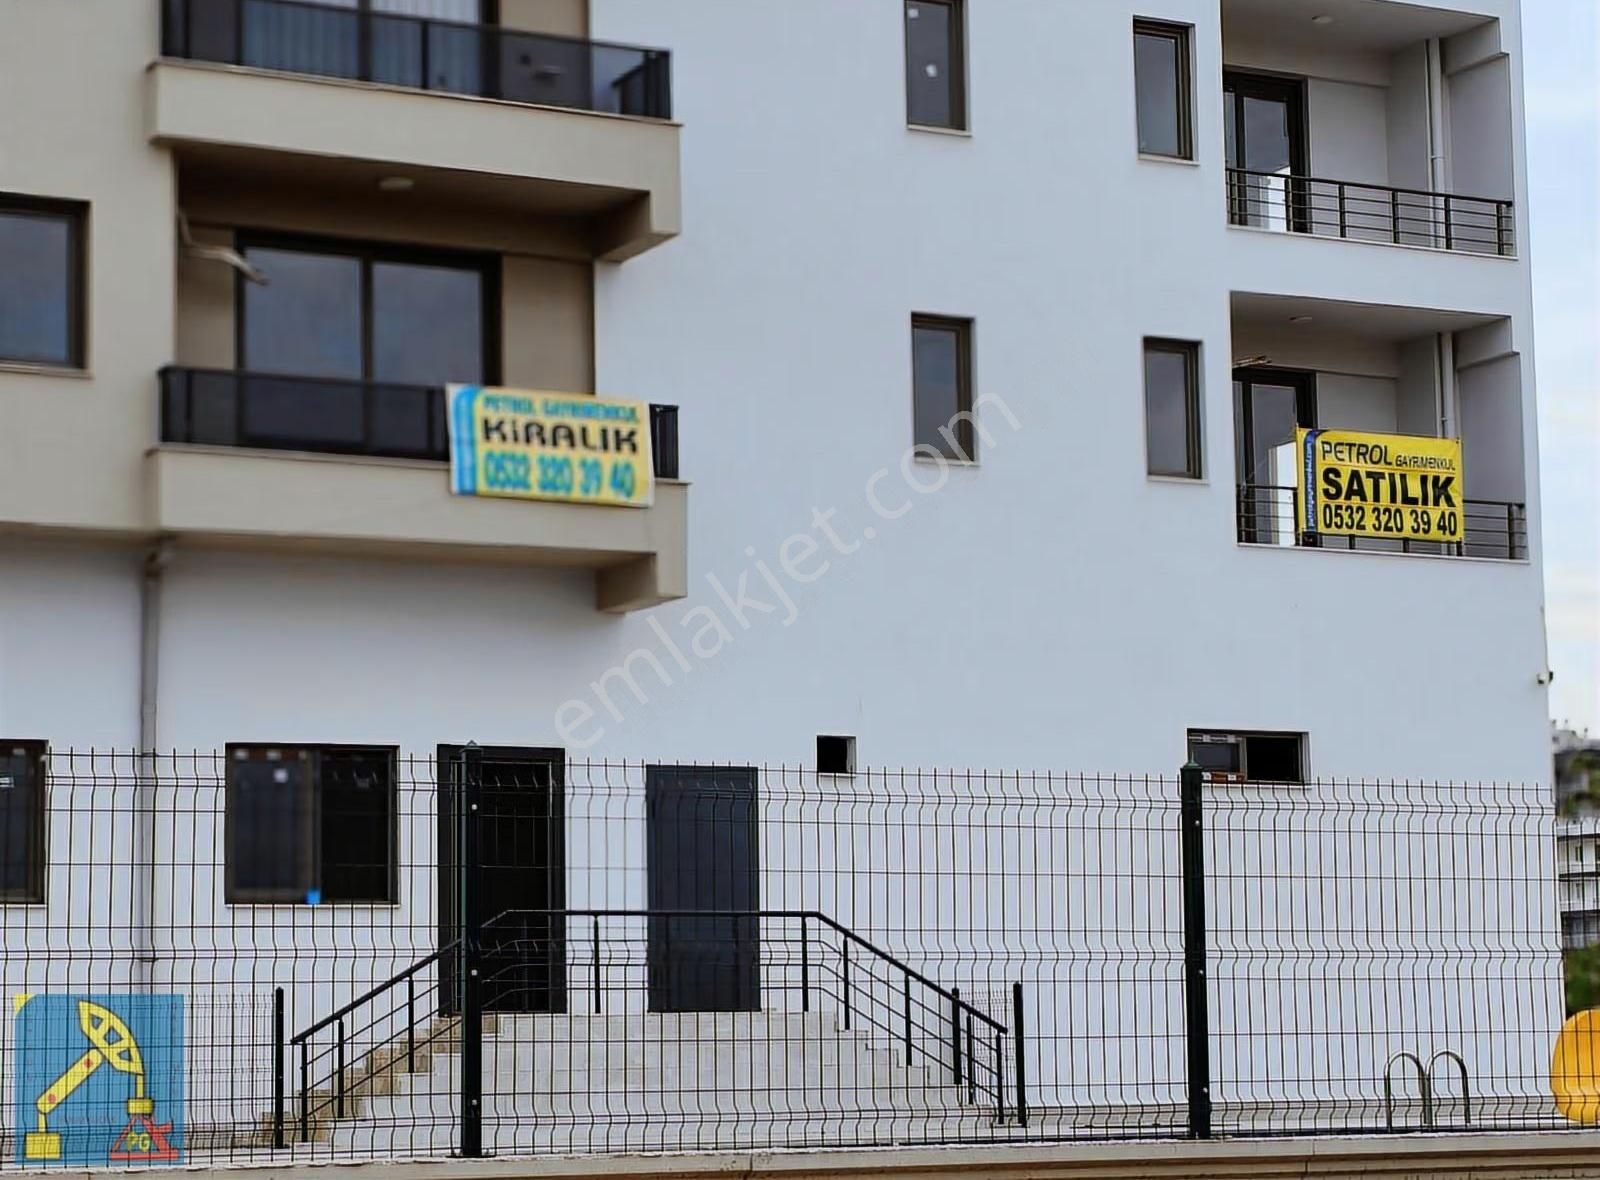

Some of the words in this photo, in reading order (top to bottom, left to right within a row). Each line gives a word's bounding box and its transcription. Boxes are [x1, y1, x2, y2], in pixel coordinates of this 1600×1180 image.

[1321, 441, 1392, 466] PETROL
[1322, 467, 1457, 508] SATILIK
[1323, 504, 1366, 531] 0532
[1372, 507, 1404, 533] 320
[1409, 509, 1431, 535] 39
[1437, 511, 1457, 536] 40
